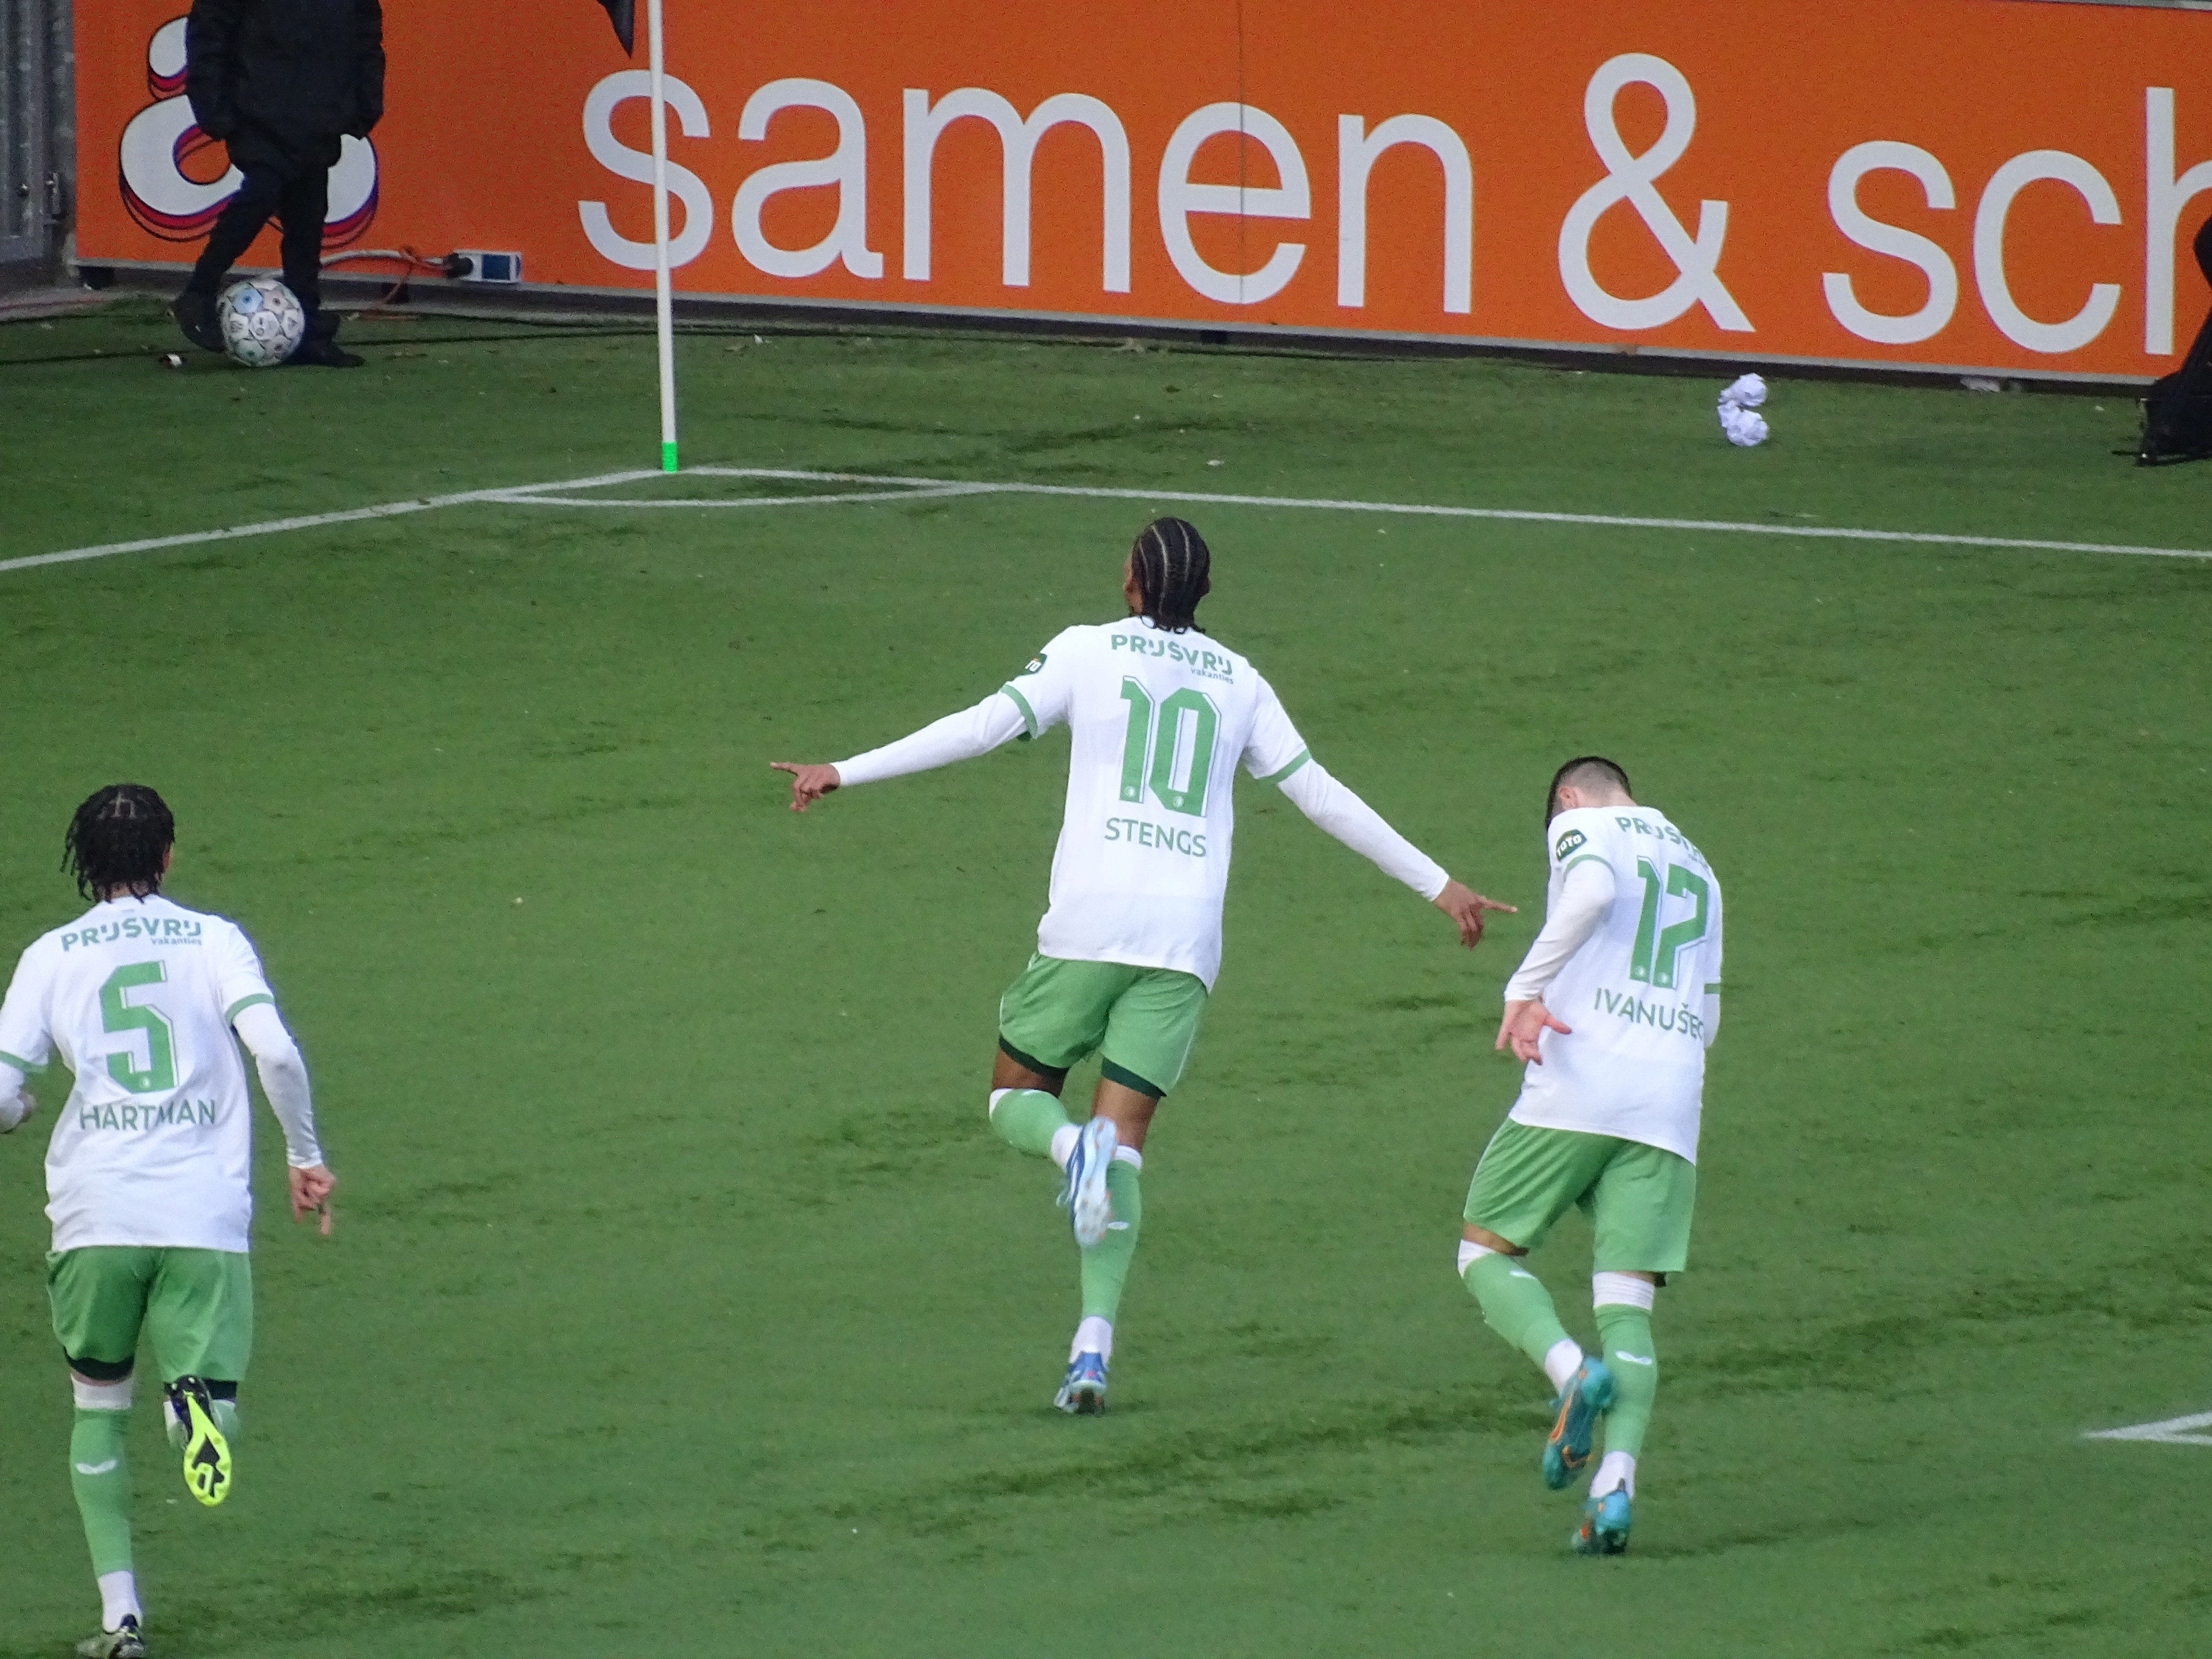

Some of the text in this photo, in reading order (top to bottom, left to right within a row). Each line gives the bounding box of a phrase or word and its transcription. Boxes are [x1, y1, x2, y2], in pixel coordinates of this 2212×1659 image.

[578, 69, 1473, 315] samen
[1559, 53, 1755, 332] &
[1191, 668, 1234, 684] vakanties
[1119, 675, 1222, 817] 10
[1104, 817, 1207, 858] STENGS
[1556, 834, 1582, 857] TOTO
[150, 937, 202, 945] vakanties
[1629, 855, 1710, 990] 12
[99, 960, 179, 1093] 5
[79, 1099, 215, 1131] HARTMAN
